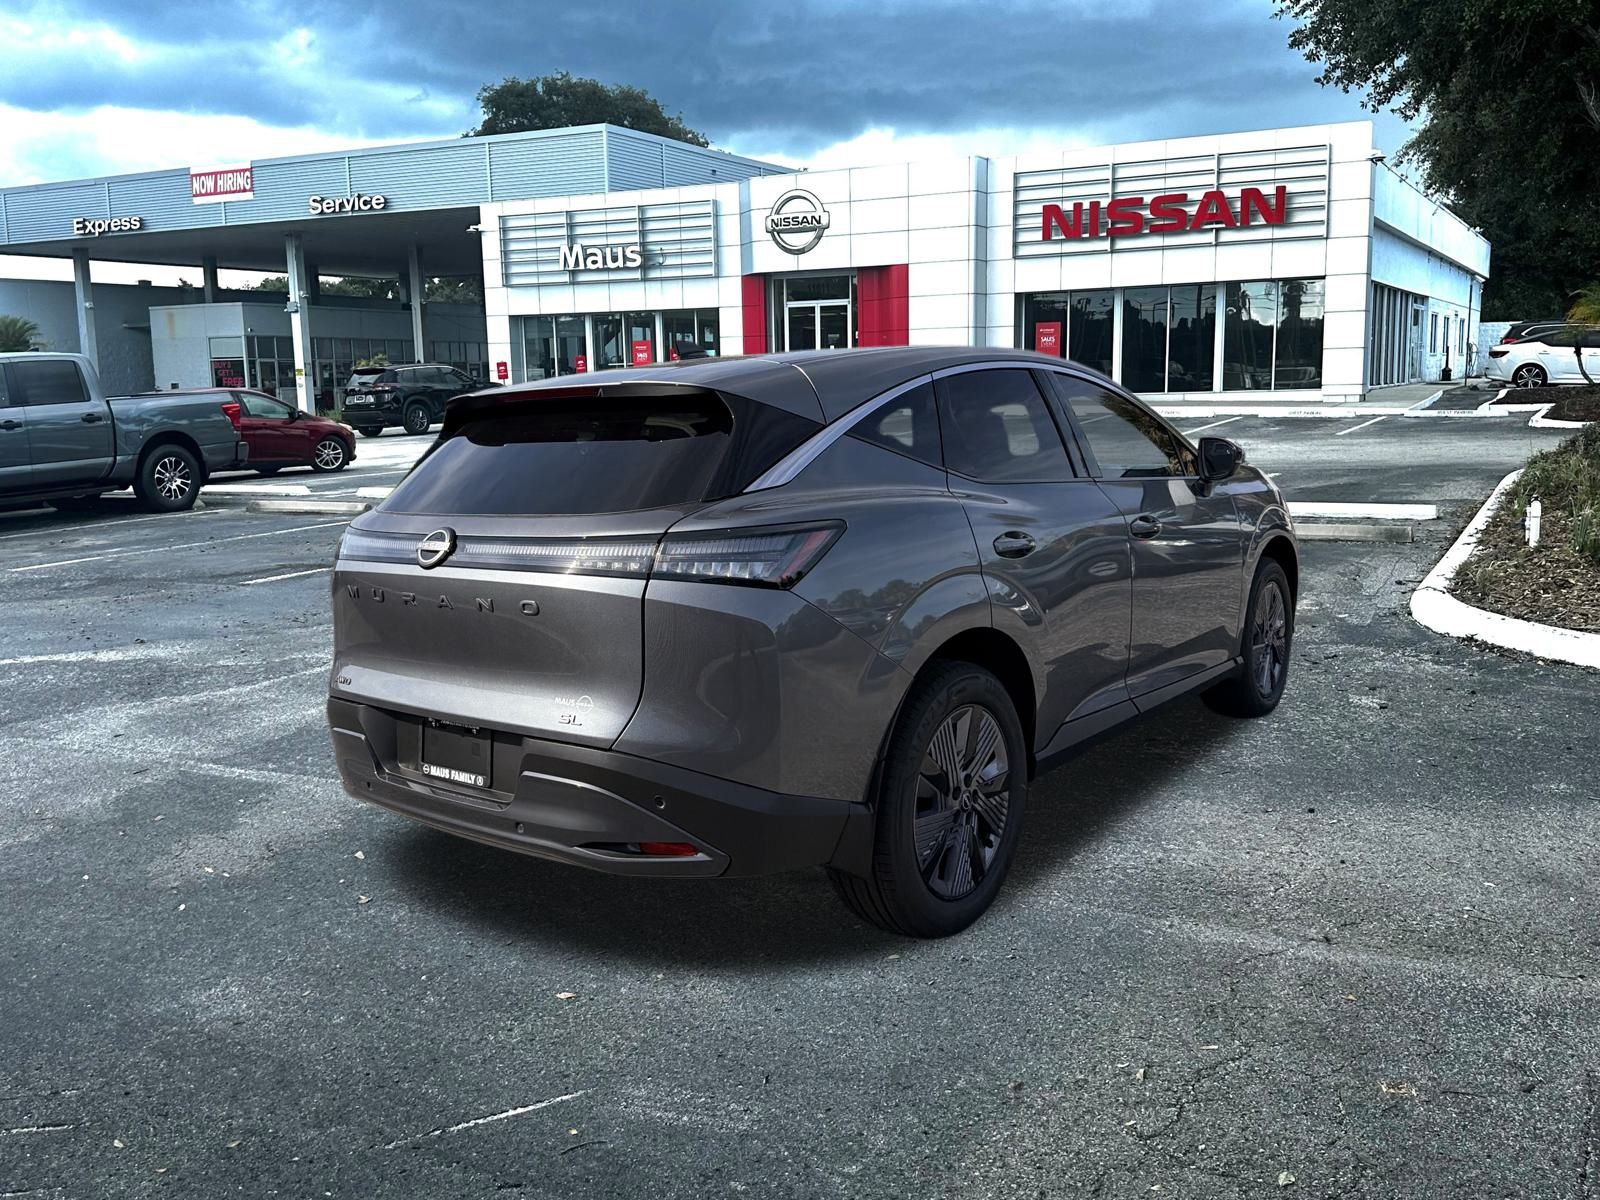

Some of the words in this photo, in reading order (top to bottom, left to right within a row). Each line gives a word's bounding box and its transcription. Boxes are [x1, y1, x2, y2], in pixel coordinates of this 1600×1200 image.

[192, 174, 215, 195] NOW
[216, 171, 251, 192] HIRING
[309, 193, 385, 215] Service
[1042, 185, 1287, 241] NISSAN
[72, 216, 141, 236] Express
[770, 214, 823, 229] NISSAN
[559, 243, 642, 270] Maus
[223, 377, 244, 387] FREE
[347, 584, 541, 617] MURANO
[558, 714, 583, 726] SL
[430, 765, 450, 779] MAUS
[450, 769, 476, 785] FAMILY
